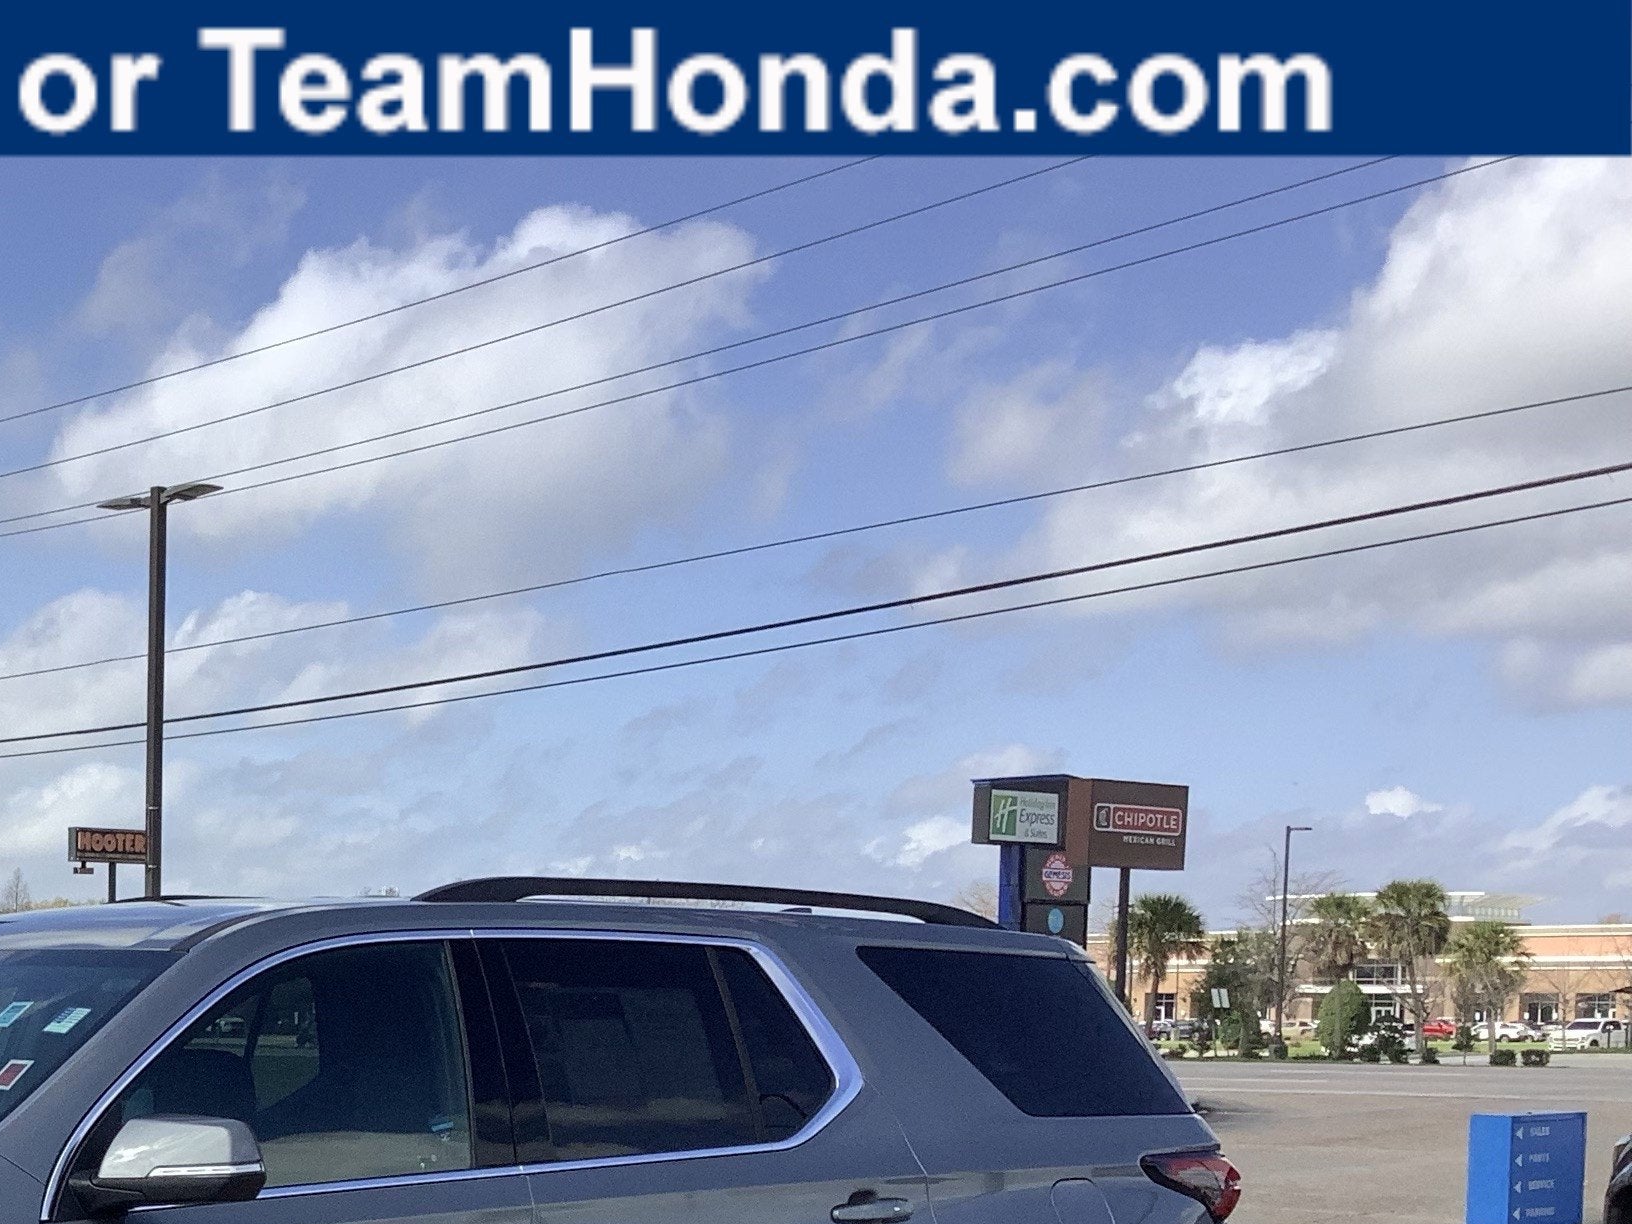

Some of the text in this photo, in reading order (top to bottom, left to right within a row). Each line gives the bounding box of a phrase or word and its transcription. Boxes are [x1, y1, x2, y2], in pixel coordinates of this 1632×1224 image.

[1019, 809, 1055, 826] Express
[1114, 810, 1179, 830] CHIPOTLE
[77, 831, 146, 853] HOOTER
